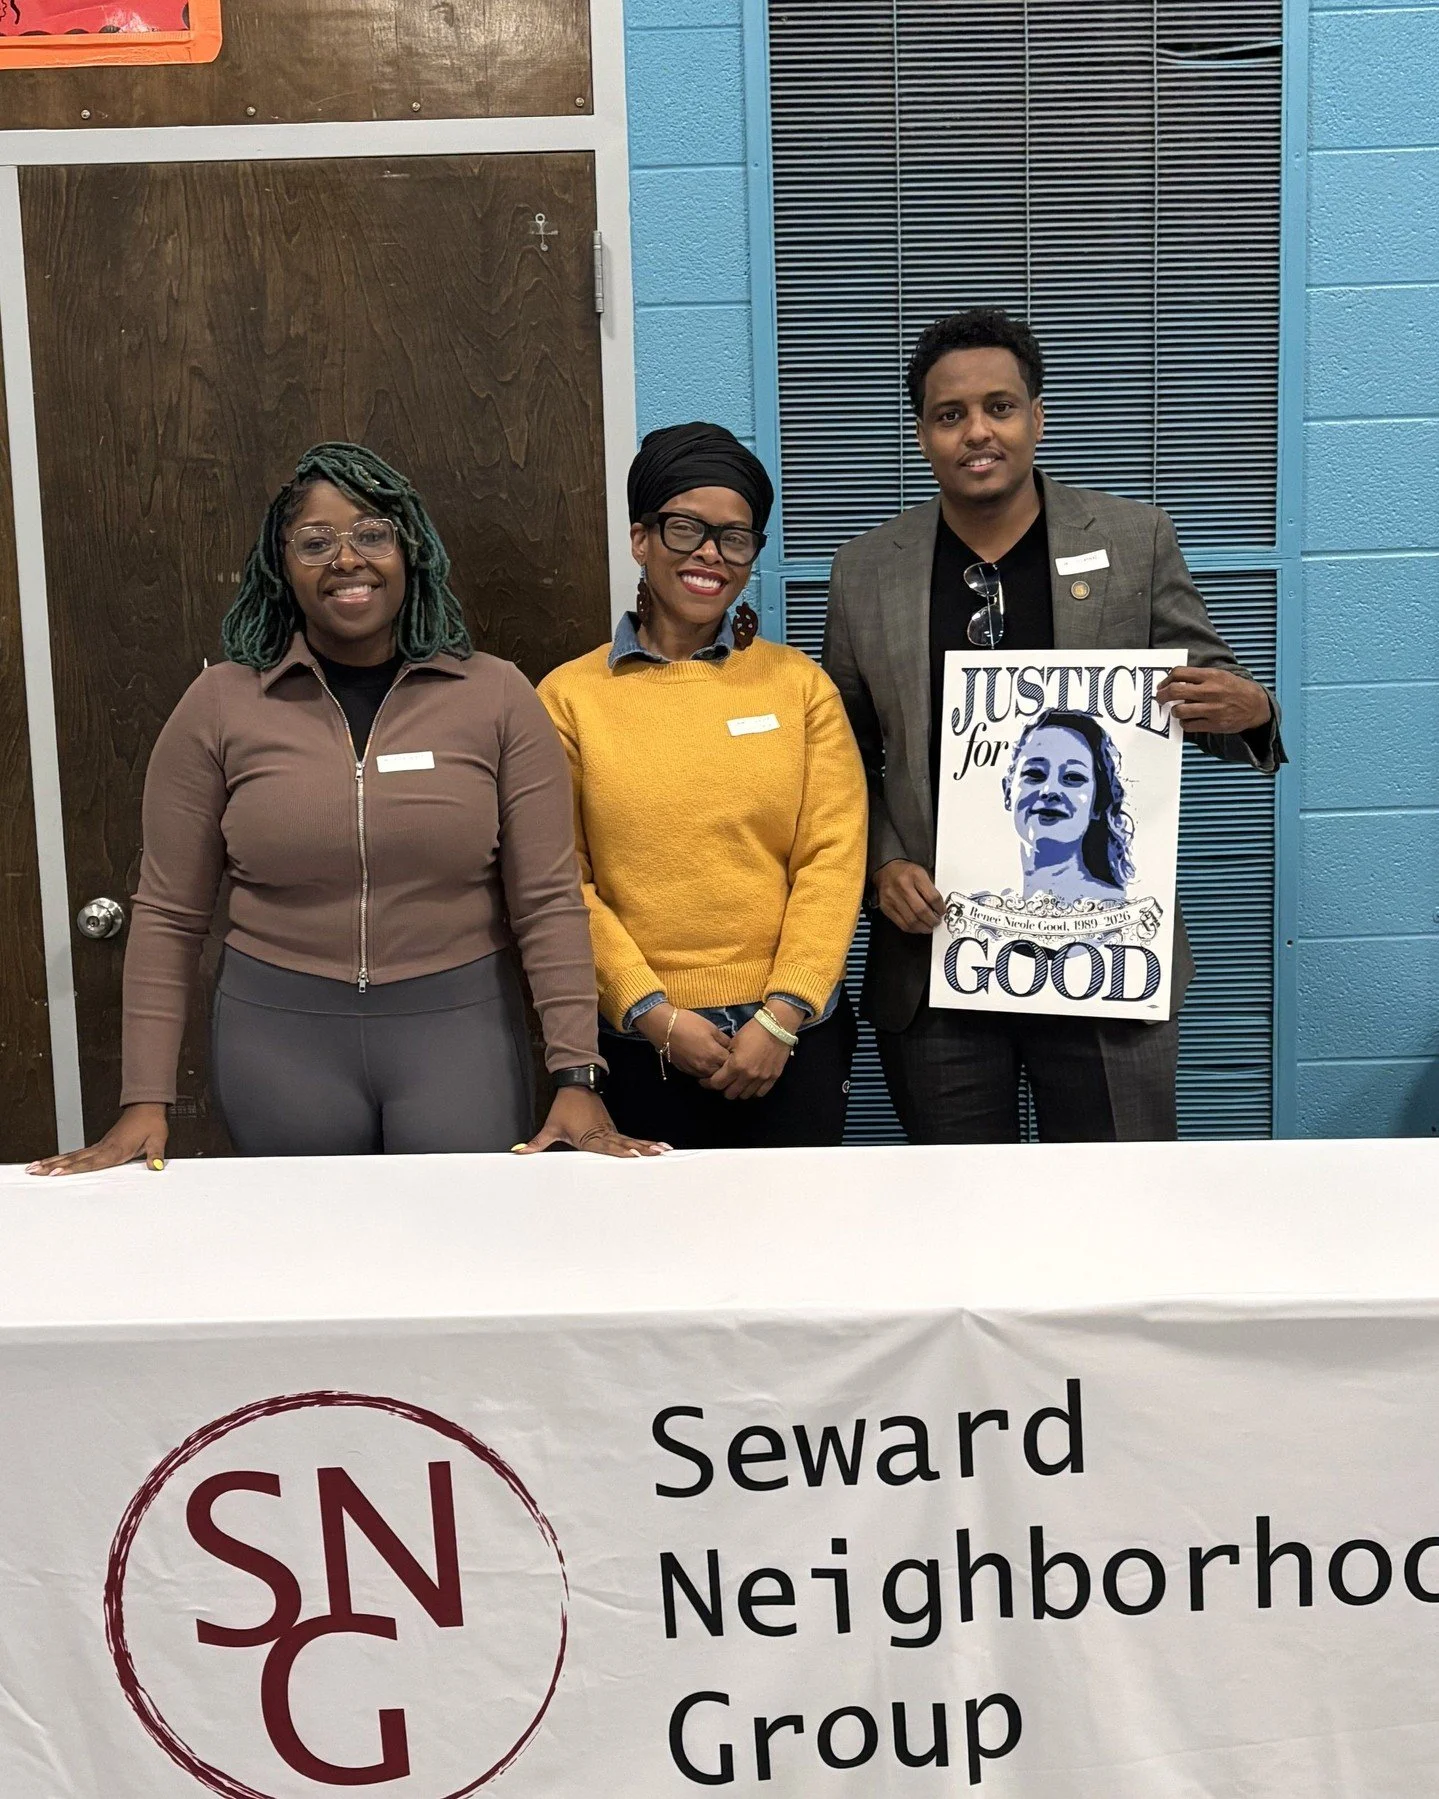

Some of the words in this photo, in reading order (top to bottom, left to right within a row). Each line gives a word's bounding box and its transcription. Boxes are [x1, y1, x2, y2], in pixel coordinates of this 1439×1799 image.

[952, 666, 1173, 739] JUSTICE
[953, 722, 1009, 781] for
[1004, 916, 1035, 930] Nicole
[1038, 920, 1070, 932] Good,
[944, 937, 1161, 1002] GOOD
[653, 1379, 1084, 1498] Seward
[669, 1691, 1023, 1786] Group
